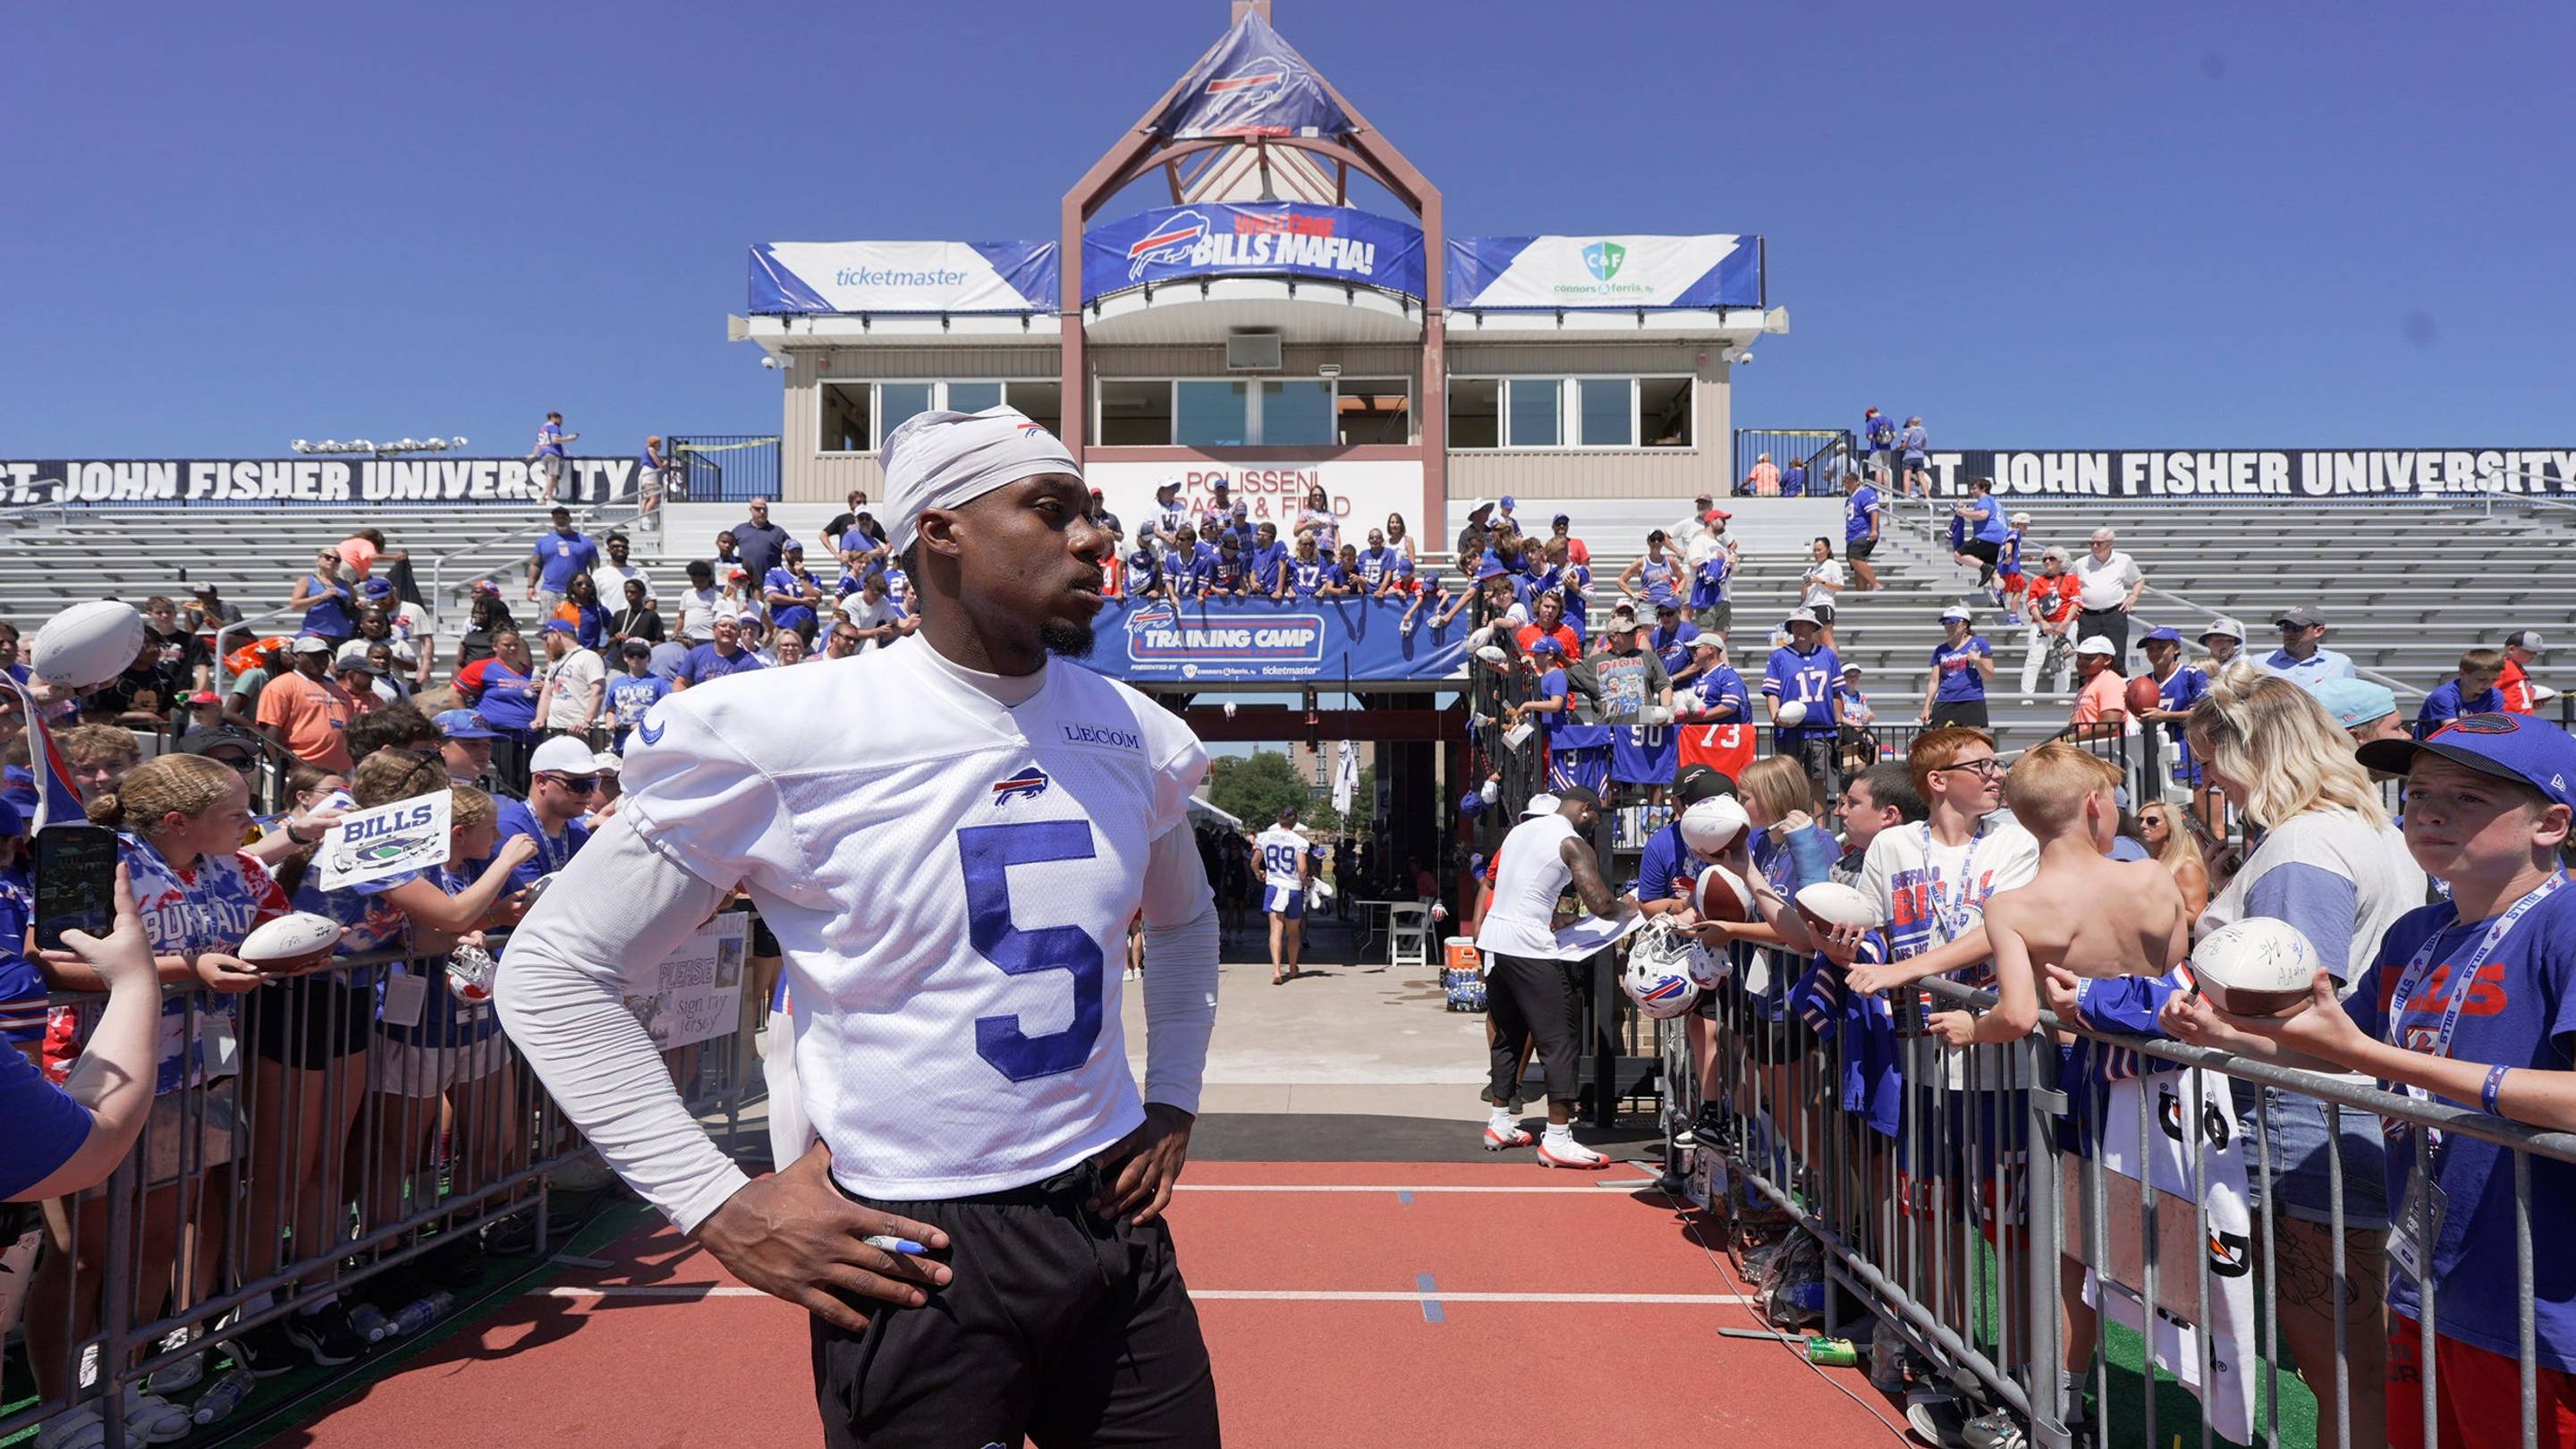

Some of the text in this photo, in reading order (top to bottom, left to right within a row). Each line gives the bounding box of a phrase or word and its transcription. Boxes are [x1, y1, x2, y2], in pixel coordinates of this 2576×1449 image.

[1191, 233, 1375, 275] BILLS MAFIA!
[836, 267, 969, 287] ticketmaster
[1554, 284, 1597, 293] connors
[51, 462, 177, 503] JOHN
[184, 462, 350, 501] FISHER
[1187, 470, 1318, 495] POLISSENI
[1987, 452, 2109, 496] JOHN
[2122, 452, 2292, 495] FISHER
[1254, 496, 1270, 520] &
[1174, 576, 1193, 594] 17
[1297, 566, 1319, 588] 17
[1145, 629, 1316, 648] TRAINING CAMP
[1262, 665, 1317, 676] ticketmaster
[1597, 657, 1645, 677] DION
[1795, 670, 1829, 703] 17
[1067, 724, 1140, 750] LECOM
[1701, 724, 1741, 749] 73
[343, 803, 433, 843] BILLS
[1266, 843, 1296, 875] 89
[2505, 892, 2543, 920] BILLS
[956, 819, 1104, 1083] 5
[1894, 946, 1912, 962] AFC
[2463, 946, 2488, 979] BILLS
[657, 957, 716, 990] PLEASE
[708, 995, 727, 1018] my
[2394, 979, 2415, 1012] BILLS
[680, 1016, 717, 1038] jersey
[2439, 1009, 2456, 1045] BILLS
